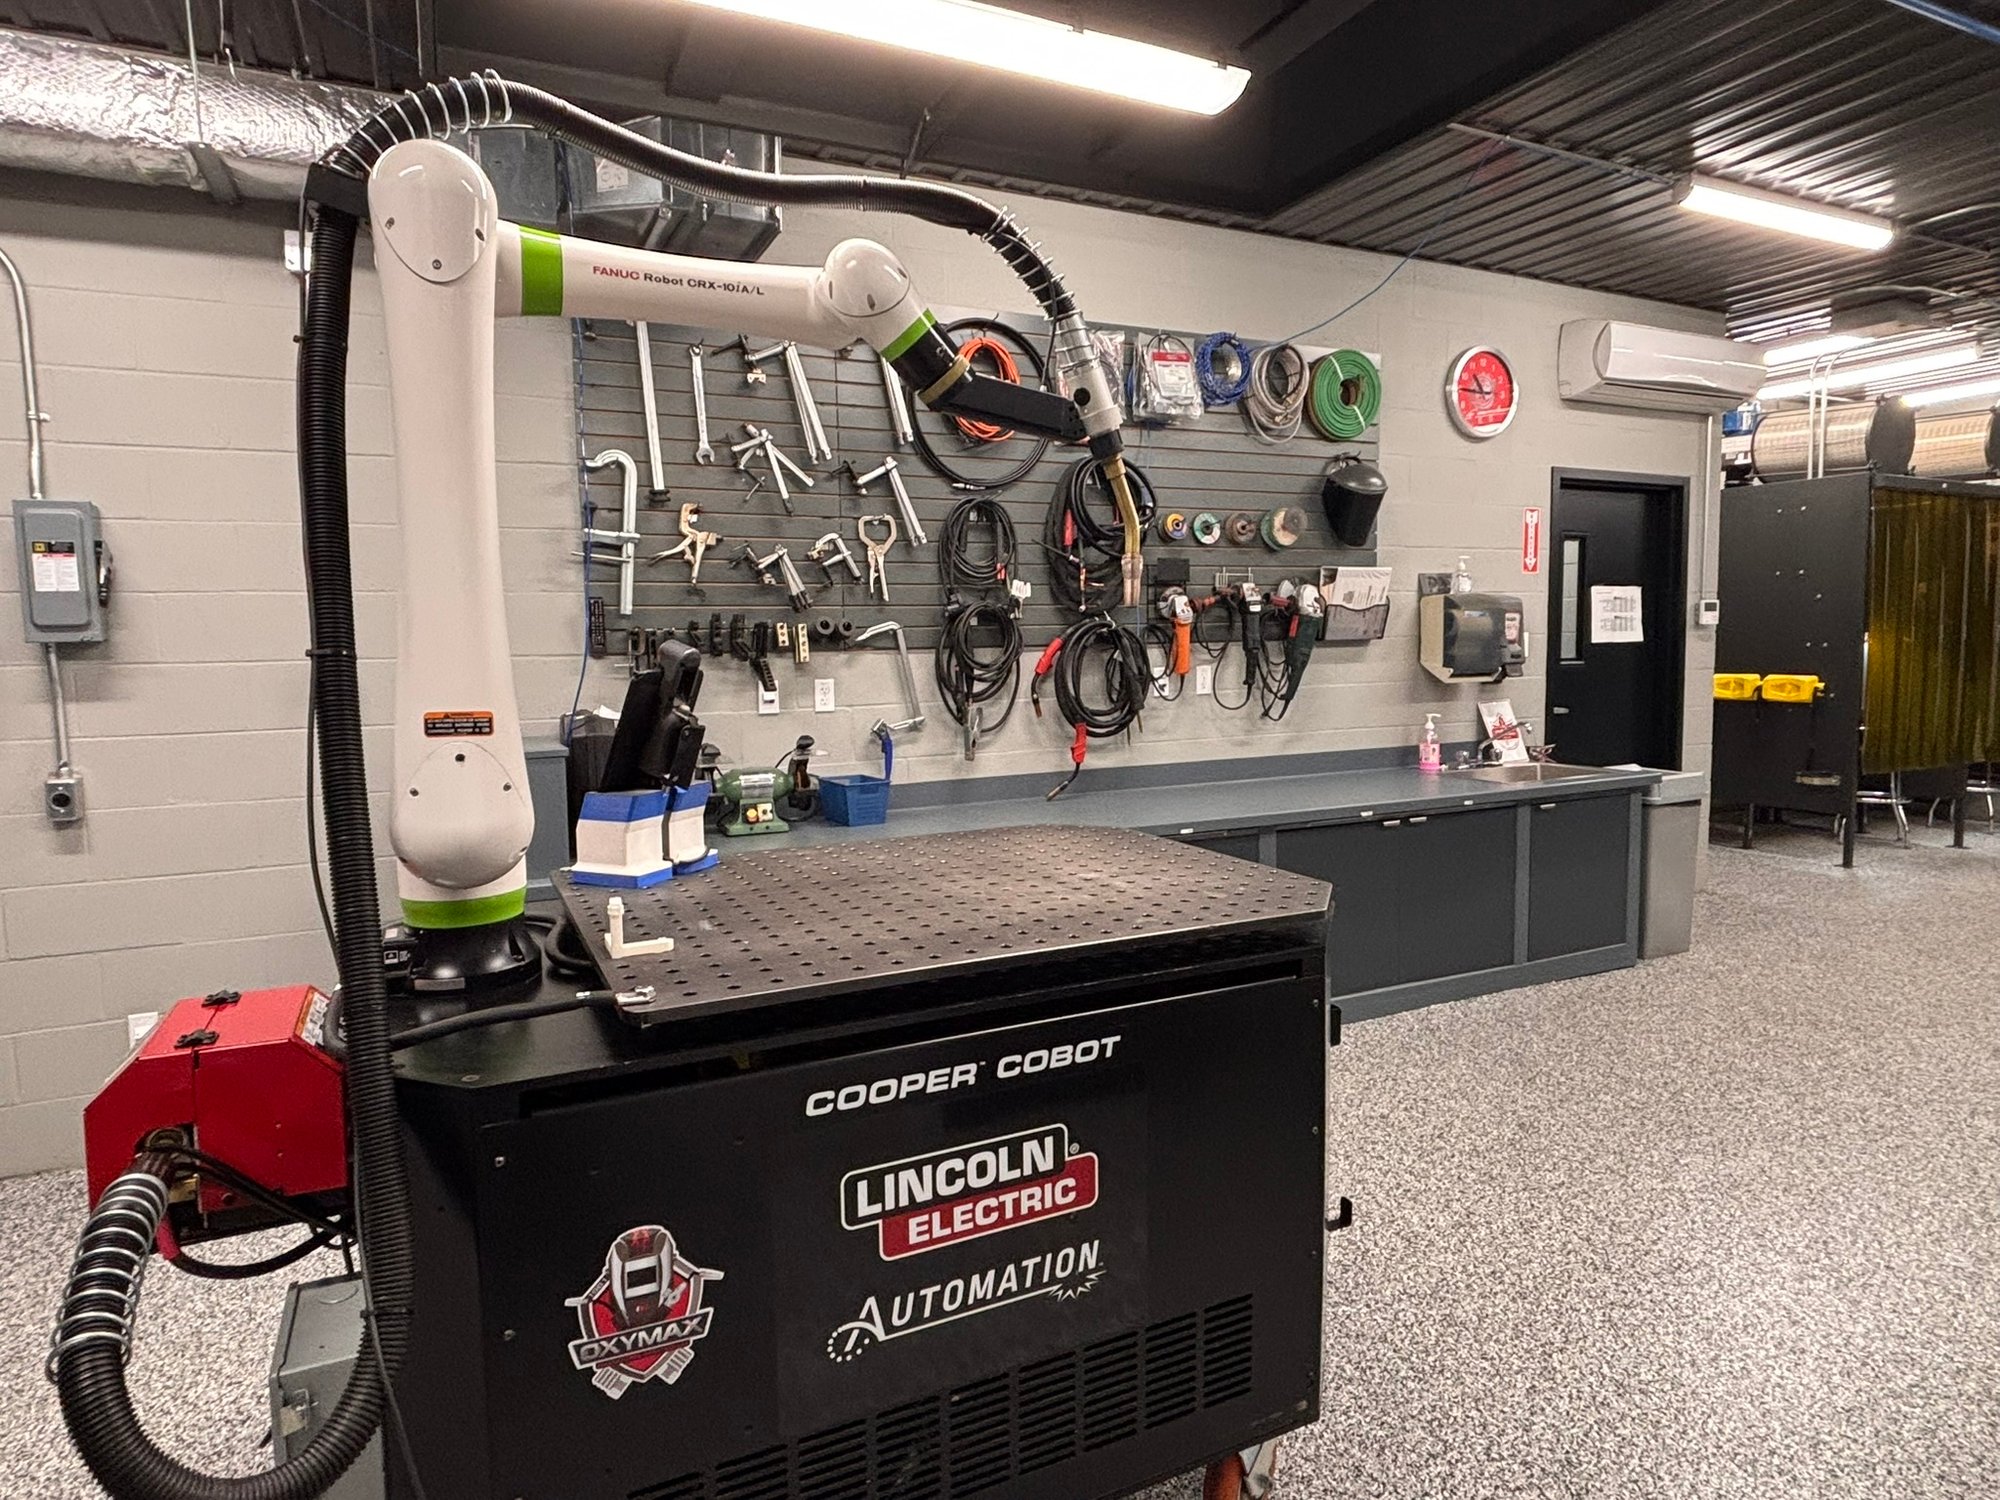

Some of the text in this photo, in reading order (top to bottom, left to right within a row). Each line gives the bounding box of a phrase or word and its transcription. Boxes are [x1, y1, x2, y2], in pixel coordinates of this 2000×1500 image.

[592, 265, 765, 296] FANUC Robot CRX-10iA/L
[996, 1035, 1122, 1079] COBOT
[857, 1135, 1054, 1218] LINCOLN
[908, 1177, 1077, 1245] ELECTRIC
[844, 1239, 1101, 1350] AUTOMATION
[580, 1316, 706, 1361] OXYMAX
